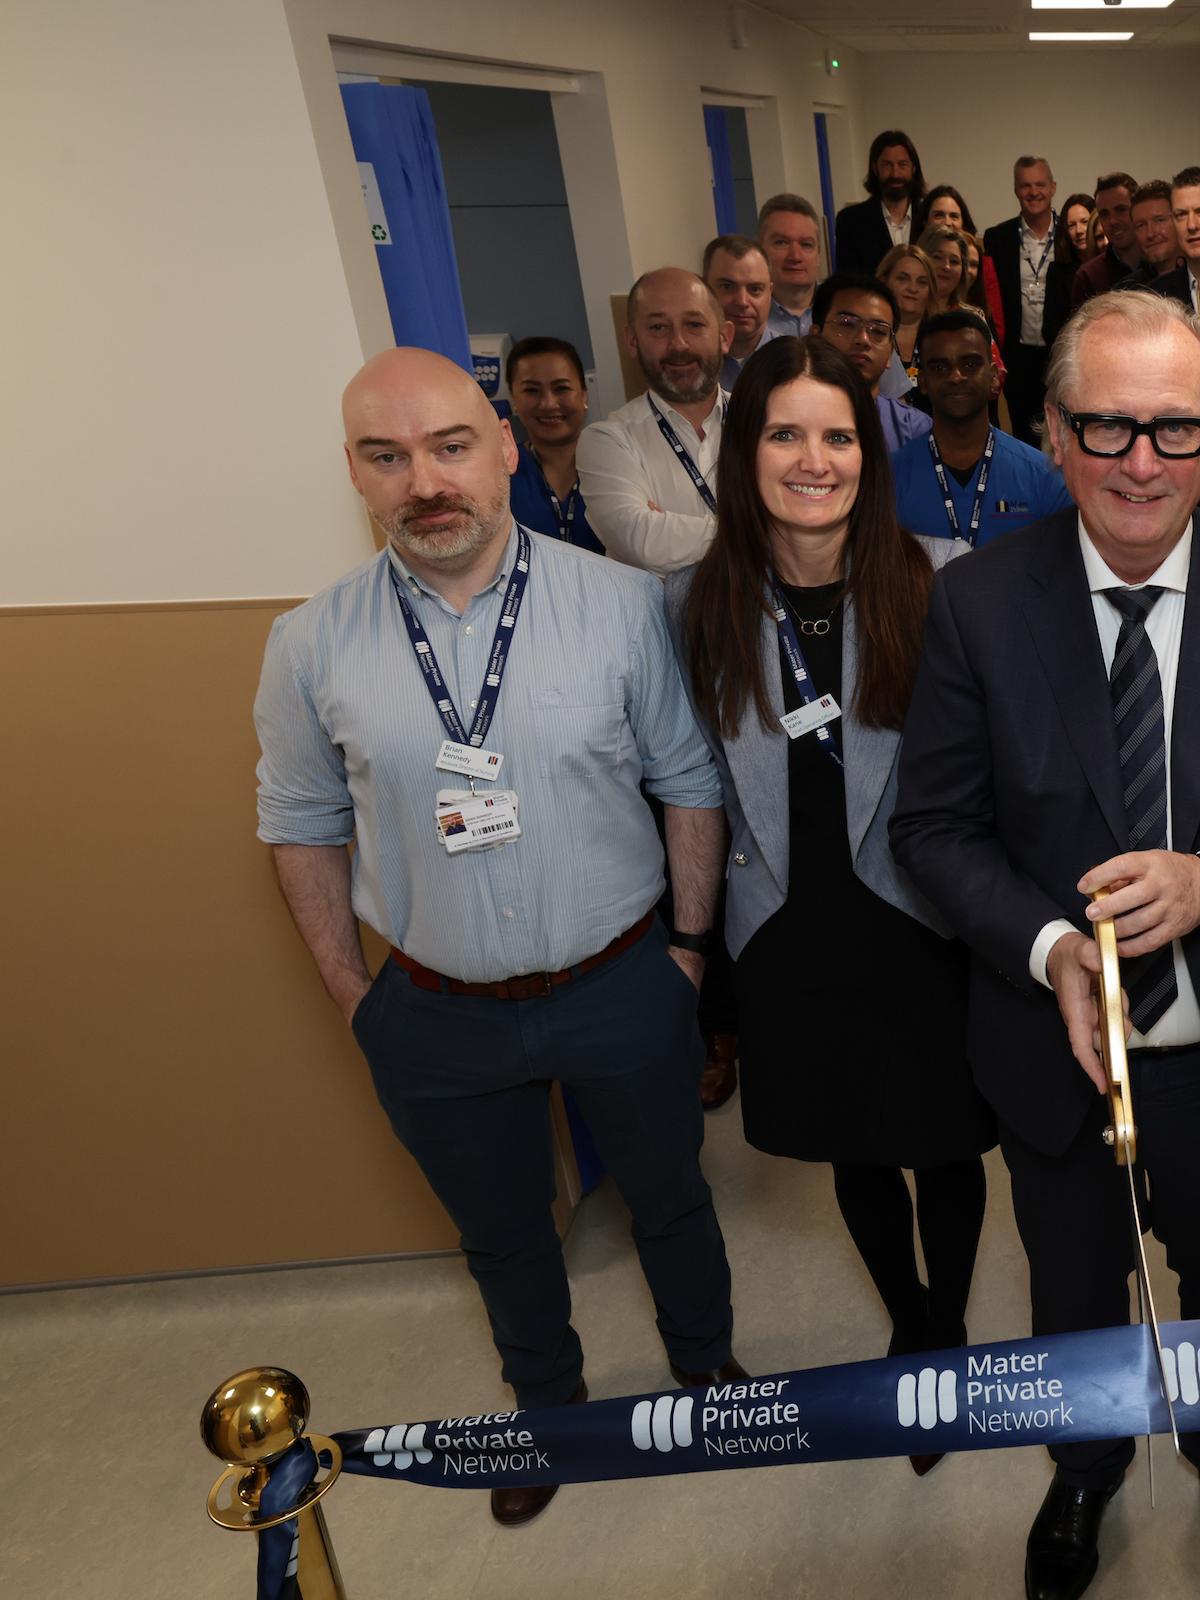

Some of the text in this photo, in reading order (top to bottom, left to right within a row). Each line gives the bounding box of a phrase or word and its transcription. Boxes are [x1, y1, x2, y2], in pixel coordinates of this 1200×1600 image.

[784, 714, 799, 724] Nikki
[788, 720, 802, 729] Kane
[442, 752, 471, 764] Kennedy
[445, 744, 463, 754] Brian
[458, 764, 474, 772] Director
[967, 1352, 1049, 1377] Mater
[704, 1379, 790, 1403] Mater
[967, 1377, 1063, 1405] Private
[437, 1409, 526, 1430] Mater
[702, 1401, 800, 1432] Private
[968, 1401, 1074, 1434] Network
[434, 1428, 534, 1451] Private
[704, 1426, 811, 1457] Network
[443, 1449, 551, 1476] Network
